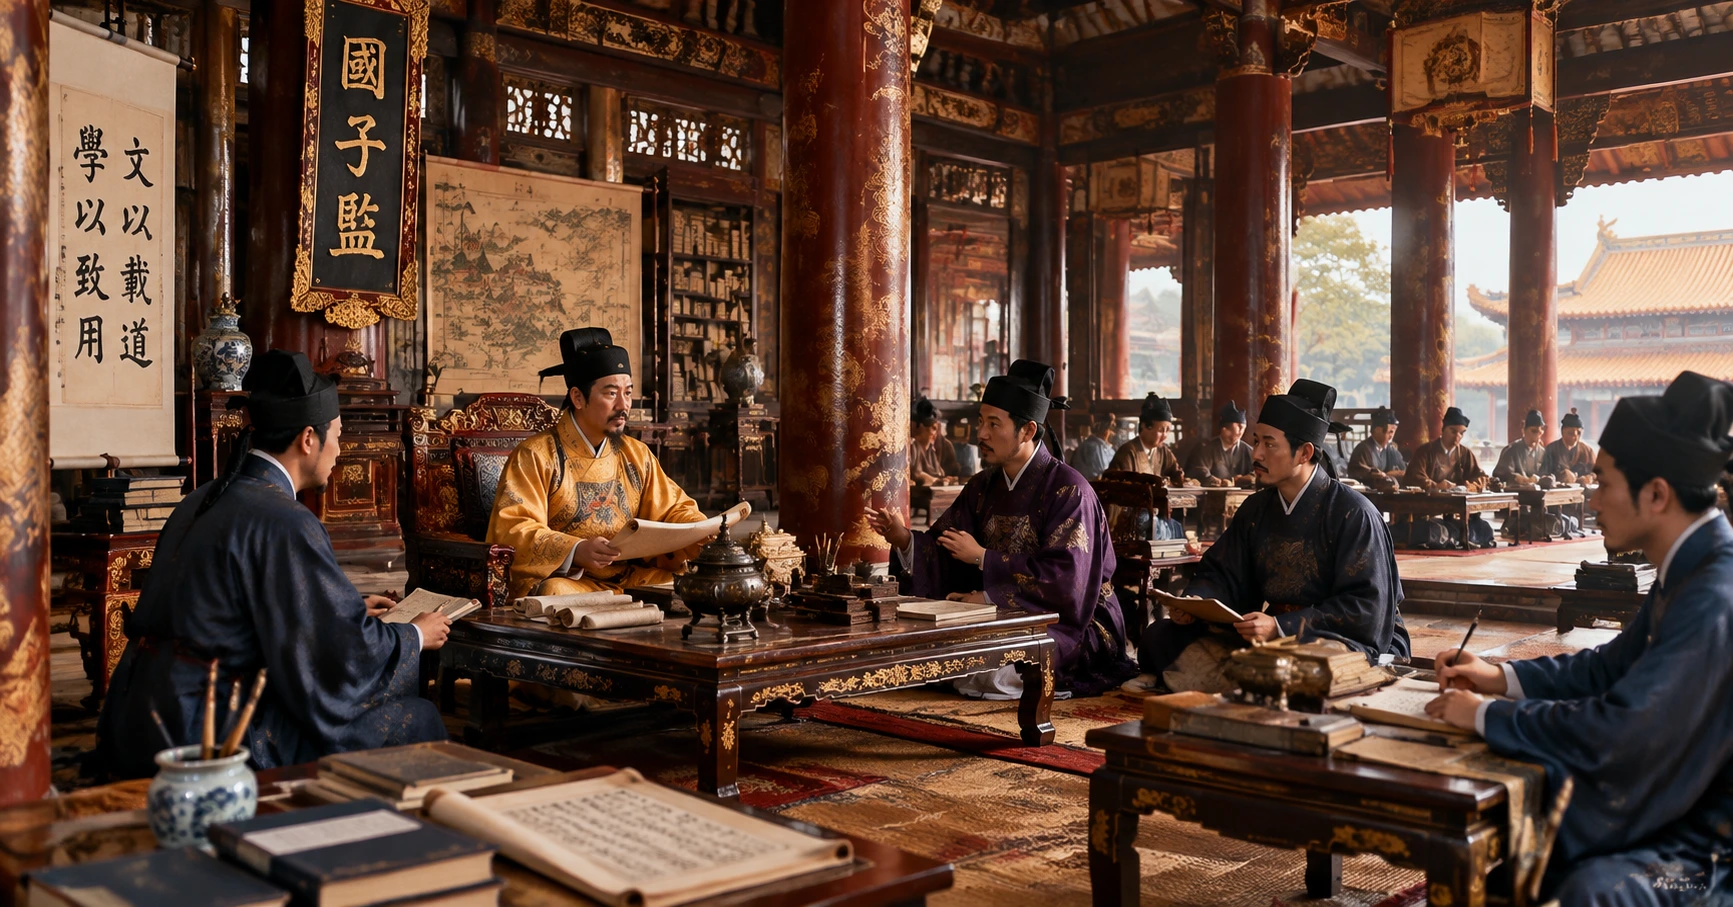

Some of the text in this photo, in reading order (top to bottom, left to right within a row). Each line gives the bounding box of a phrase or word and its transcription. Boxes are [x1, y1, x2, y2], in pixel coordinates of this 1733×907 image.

[73, 124, 110, 364] 學以致用
[119, 136, 154, 369] 文以載道
[329, 35, 387, 260] 國子監
